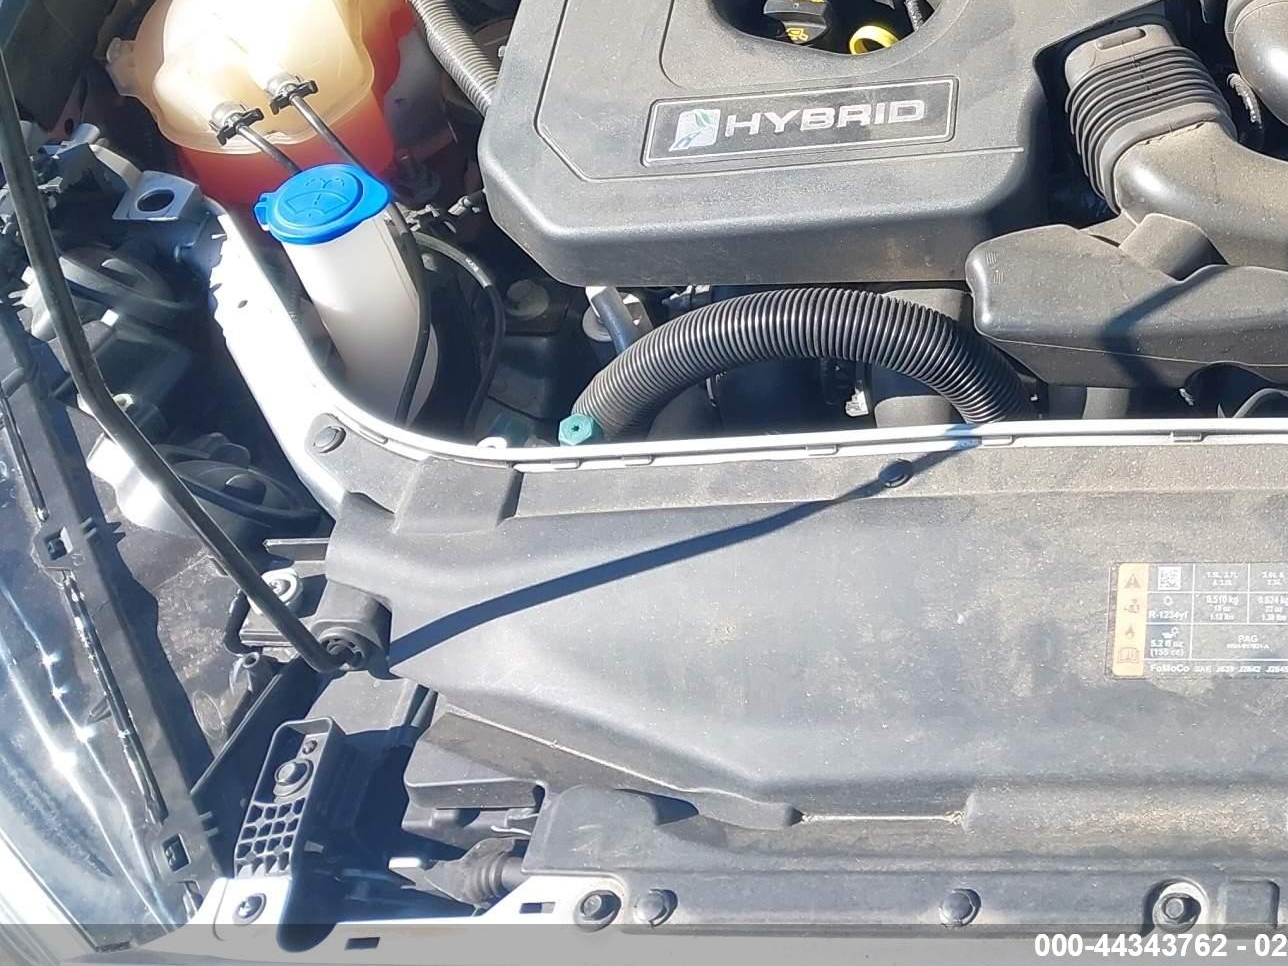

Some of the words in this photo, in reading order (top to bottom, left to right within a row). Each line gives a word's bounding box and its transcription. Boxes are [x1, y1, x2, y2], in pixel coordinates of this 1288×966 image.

[724, 100, 925, 137] HYBRID
[1228, 595, 1240, 606] kg
[1148, 610, 1188, 621] R-1234yf
[1238, 635, 1258, 643] PAG
[1150, 664, 1190, 672] FoMoCo
